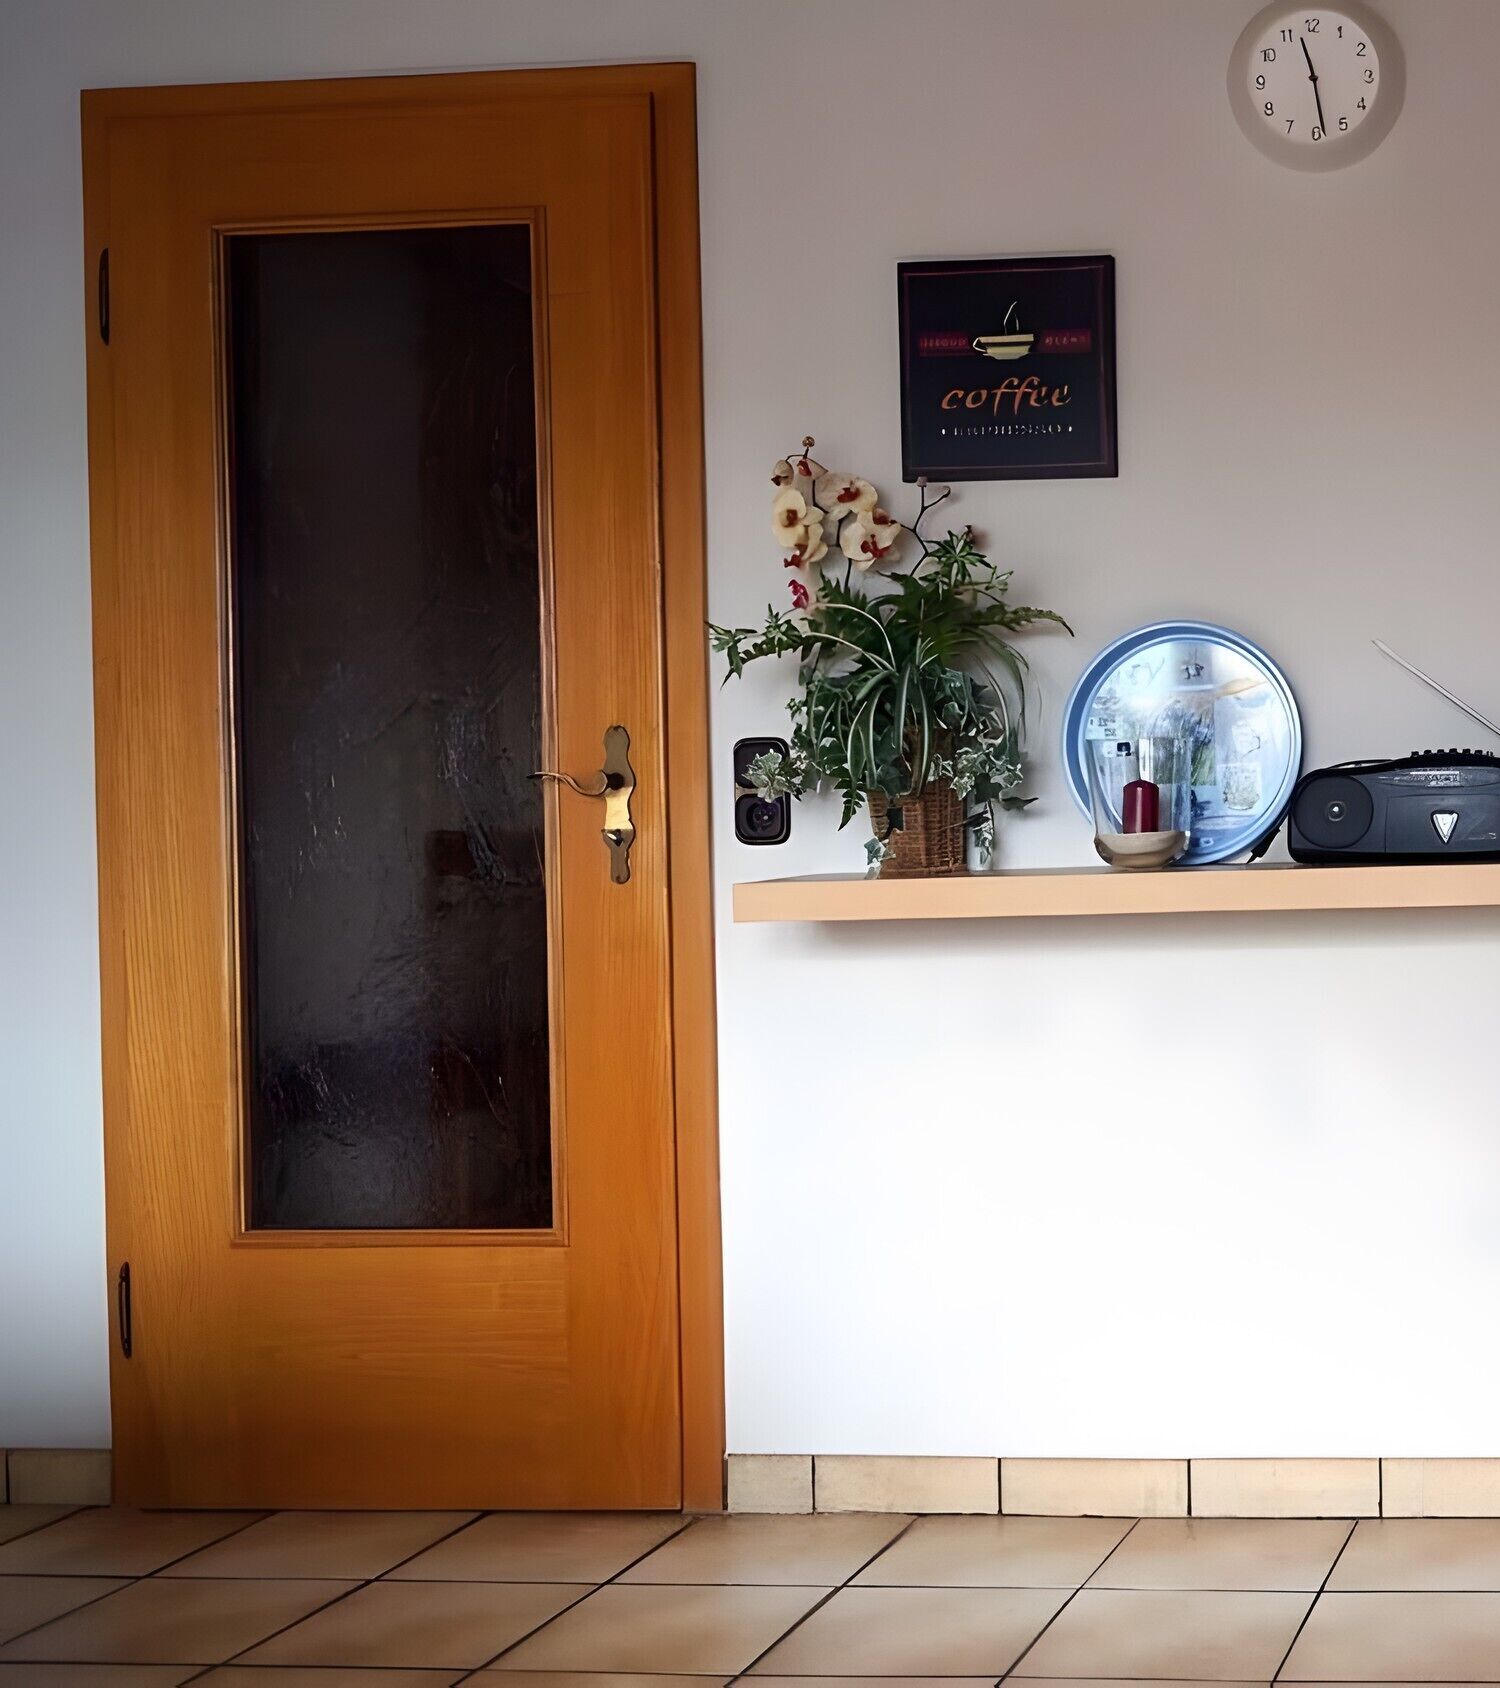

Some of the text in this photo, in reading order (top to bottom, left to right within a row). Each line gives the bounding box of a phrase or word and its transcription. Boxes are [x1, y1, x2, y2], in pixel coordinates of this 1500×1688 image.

[1304, 18, 1320, 33] 12
[1337, 26, 1343, 39] 1
[1280, 29, 1293, 43] 11
[1260, 48, 1277, 62] 10
[1356, 42, 1367, 57] 2
[1255, 75, 1266, 90] 9
[1363, 69, 1375, 84] 3
[1264, 102, 1275, 116] 8
[1356, 97, 1367, 111] 4
[1285, 119, 1295, 134] 7
[1338, 117, 1349, 131] 5
[1312, 126, 1322, 141] 6
[941, 376, 1072, 416] coffee
